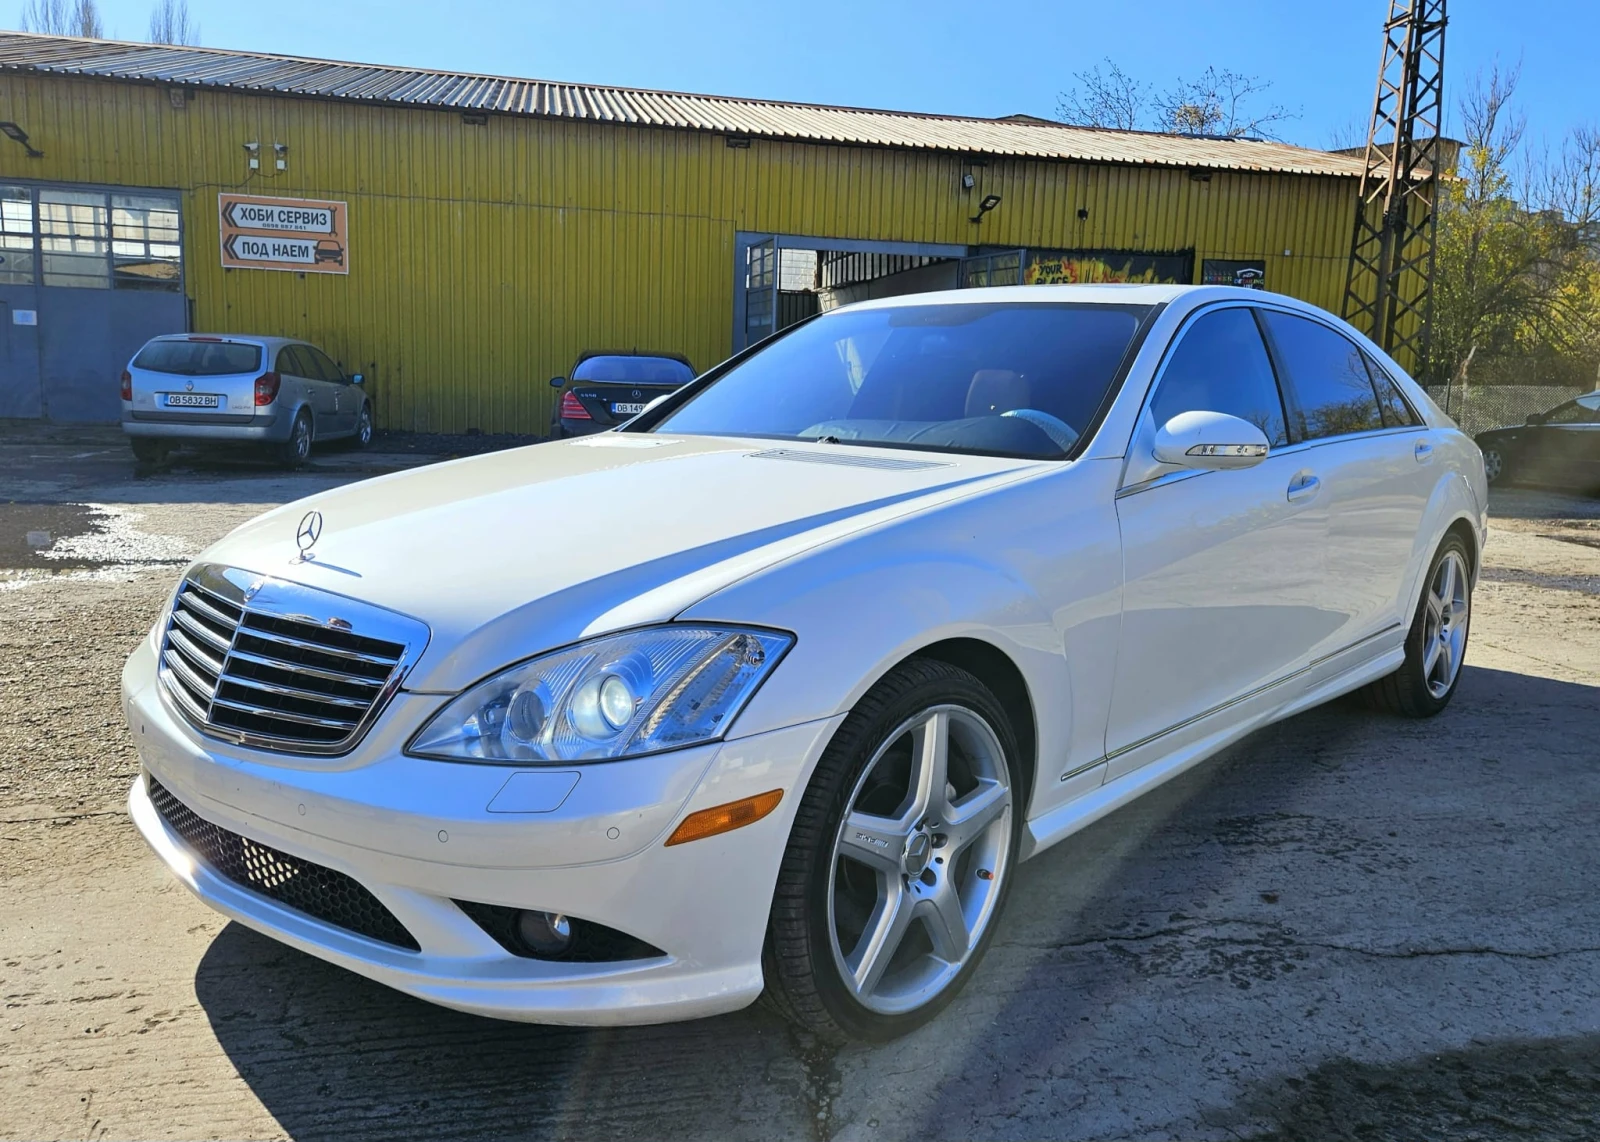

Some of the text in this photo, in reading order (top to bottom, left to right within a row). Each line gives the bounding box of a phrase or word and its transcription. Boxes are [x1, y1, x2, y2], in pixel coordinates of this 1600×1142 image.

[240, 208, 327, 226] ХОБИ СЕРВИЗ
[242, 241, 309, 258] ПОД НАЕМ
[1039, 263, 1062, 275] YOUR
[182, 396, 203, 405] 5832
